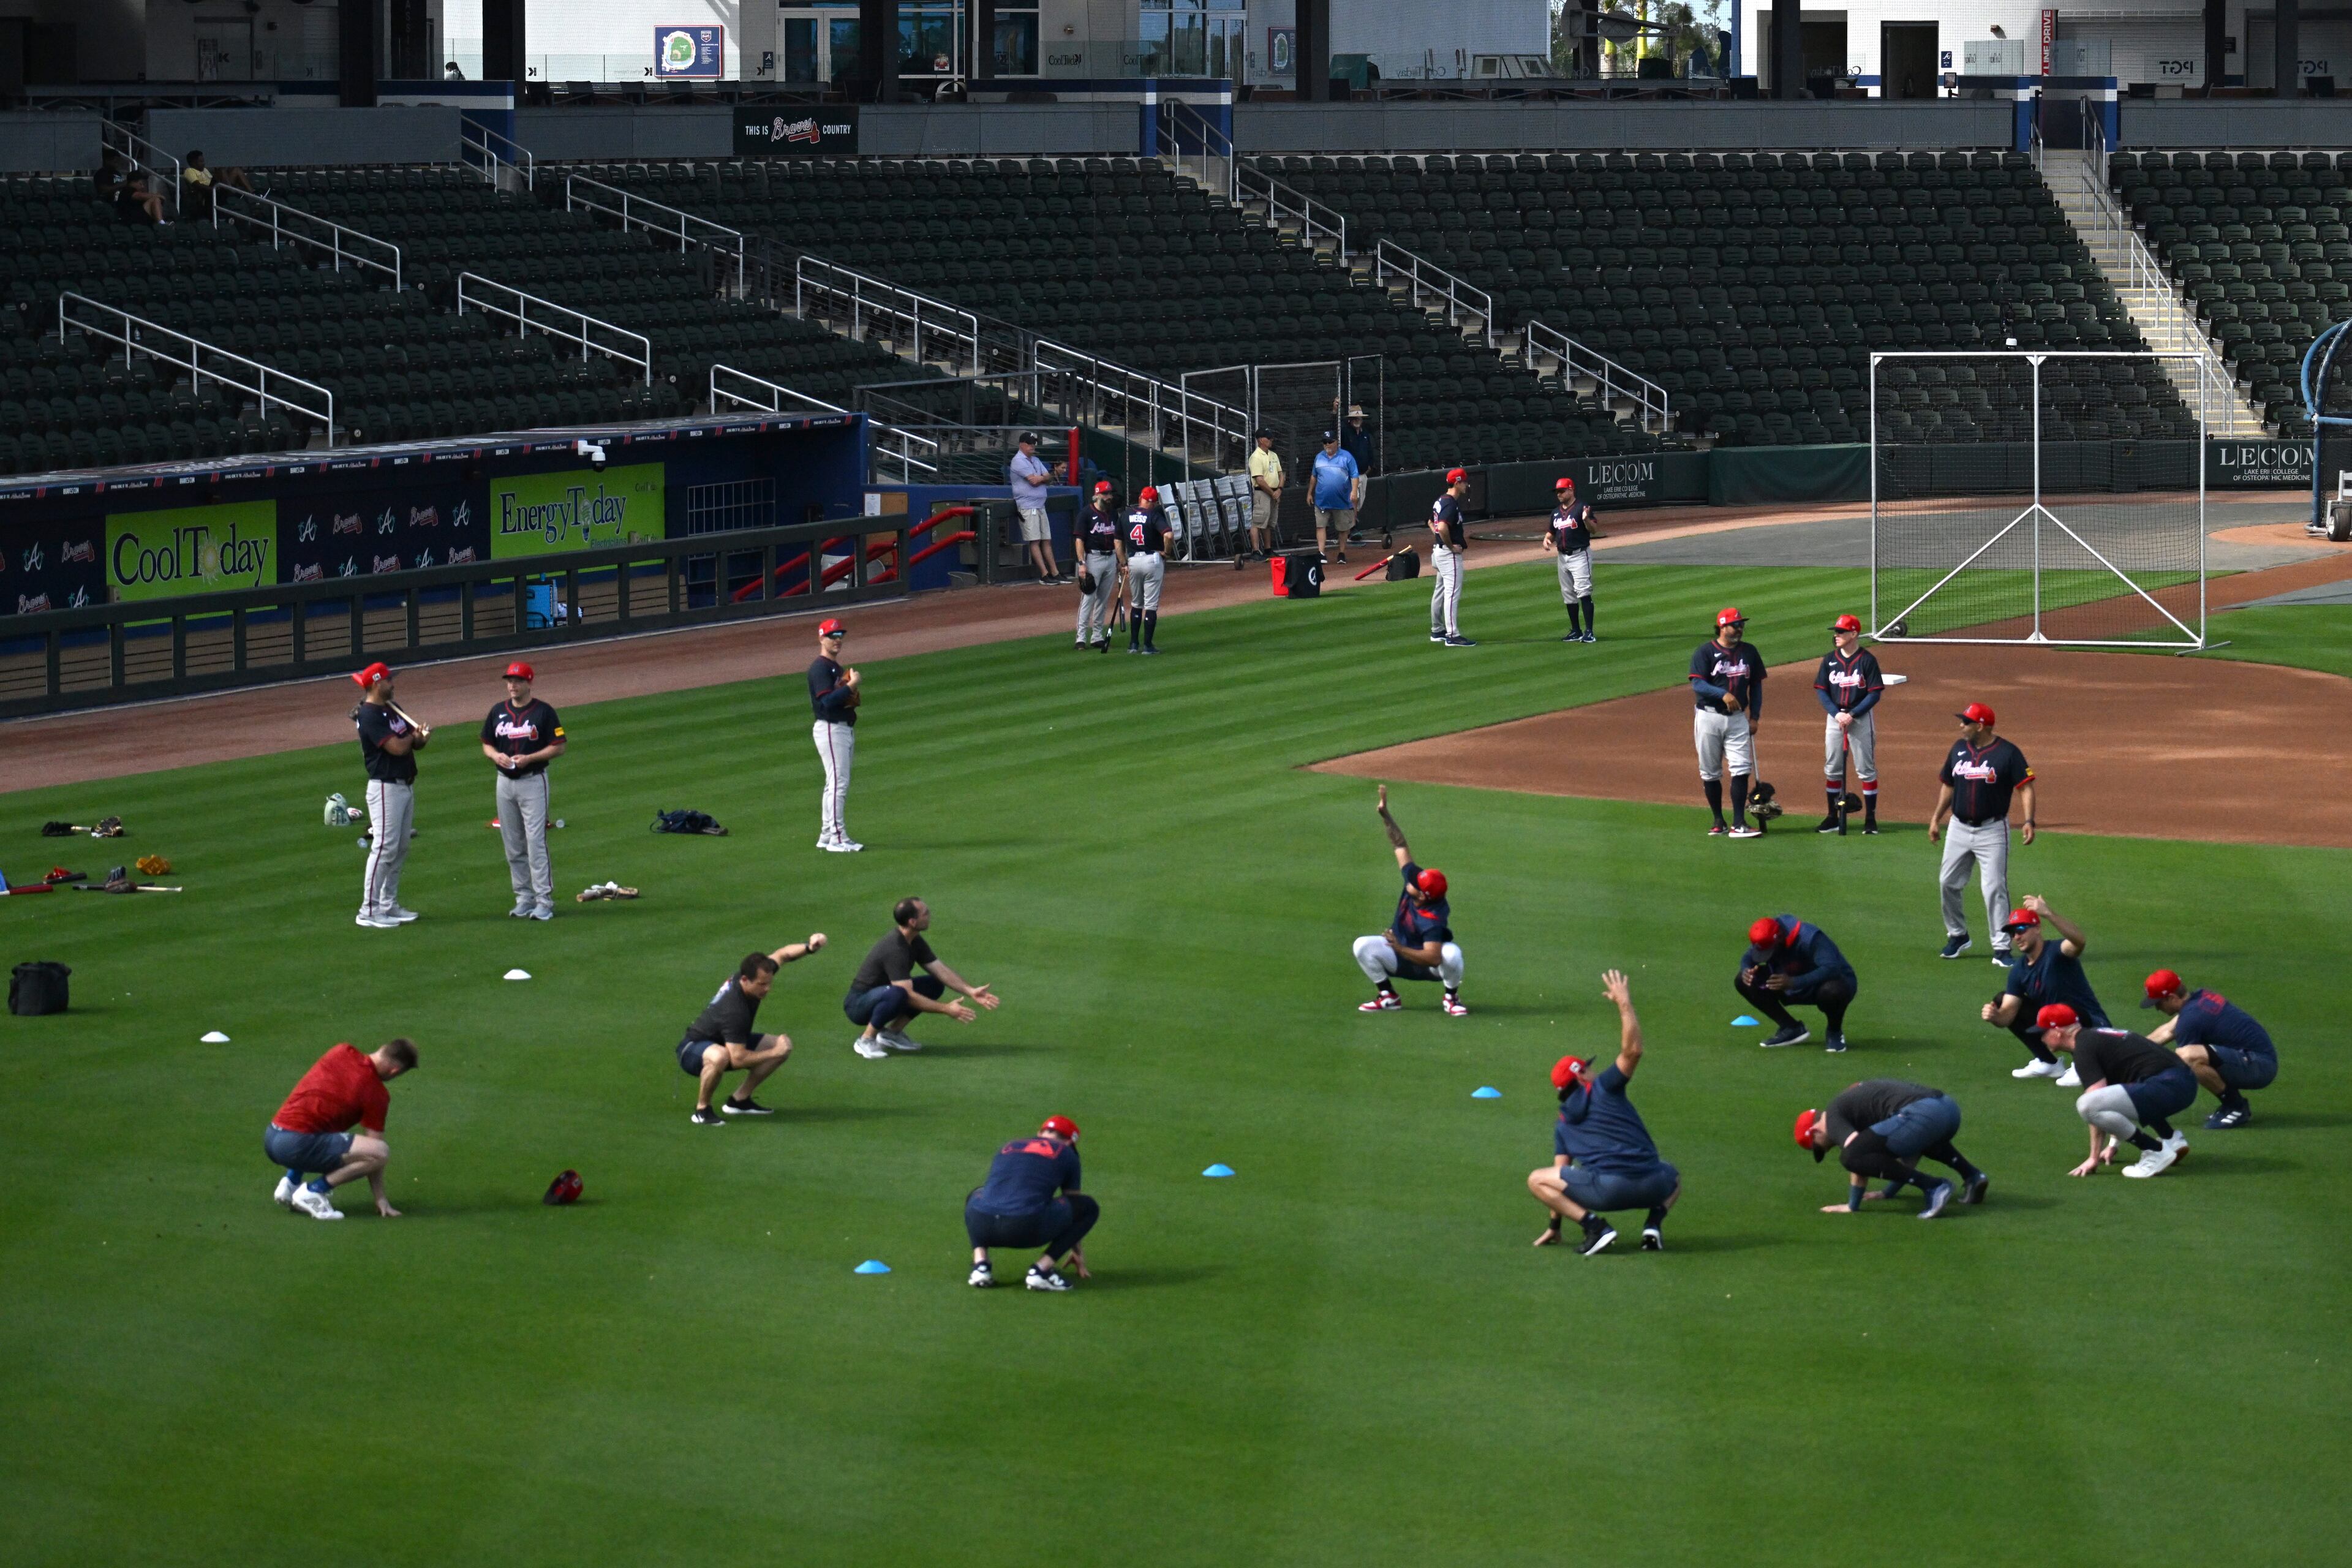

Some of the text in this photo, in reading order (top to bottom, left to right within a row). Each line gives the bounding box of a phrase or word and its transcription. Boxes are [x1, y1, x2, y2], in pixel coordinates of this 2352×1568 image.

[745, 117, 851, 143] THIS IS Braves COUNTRY
[1588, 462, 1654, 484] LECOM
[1129, 514, 1148, 524] WEISS
[1130, 524, 1145, 546] 4
